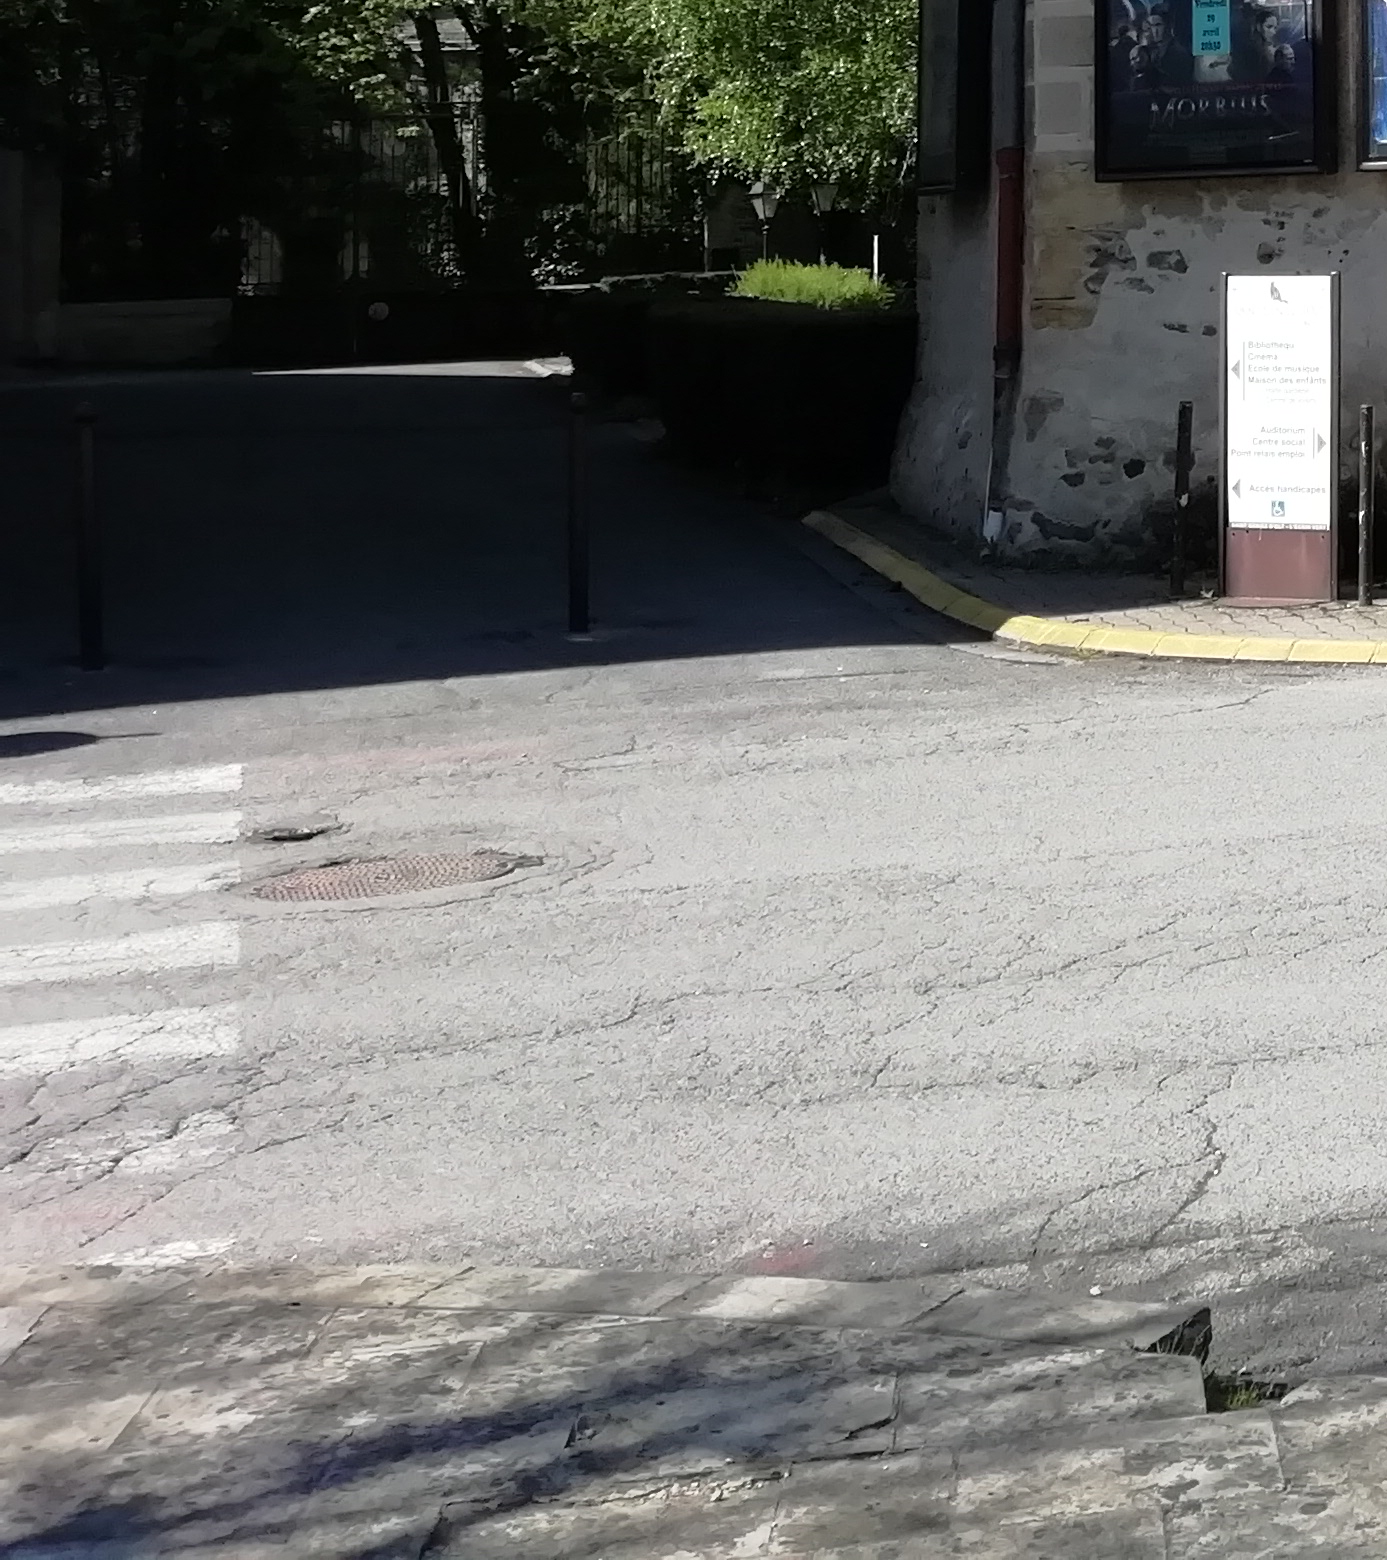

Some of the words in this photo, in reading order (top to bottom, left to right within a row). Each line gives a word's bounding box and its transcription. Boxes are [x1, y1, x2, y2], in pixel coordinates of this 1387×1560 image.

[1150, 93, 1271, 129] MORBIUS
[1273, 365, 1282, 373] de
[1285, 365, 1320, 375] musique
[1248, 376, 1277, 384] Maison
[1296, 376, 1327, 385] enfants
[1260, 426, 1306, 434] Auditorium
[1253, 438, 1279, 446] Centre
[1281, 438, 1306, 446] social
[1231, 449, 1252, 457] Point
